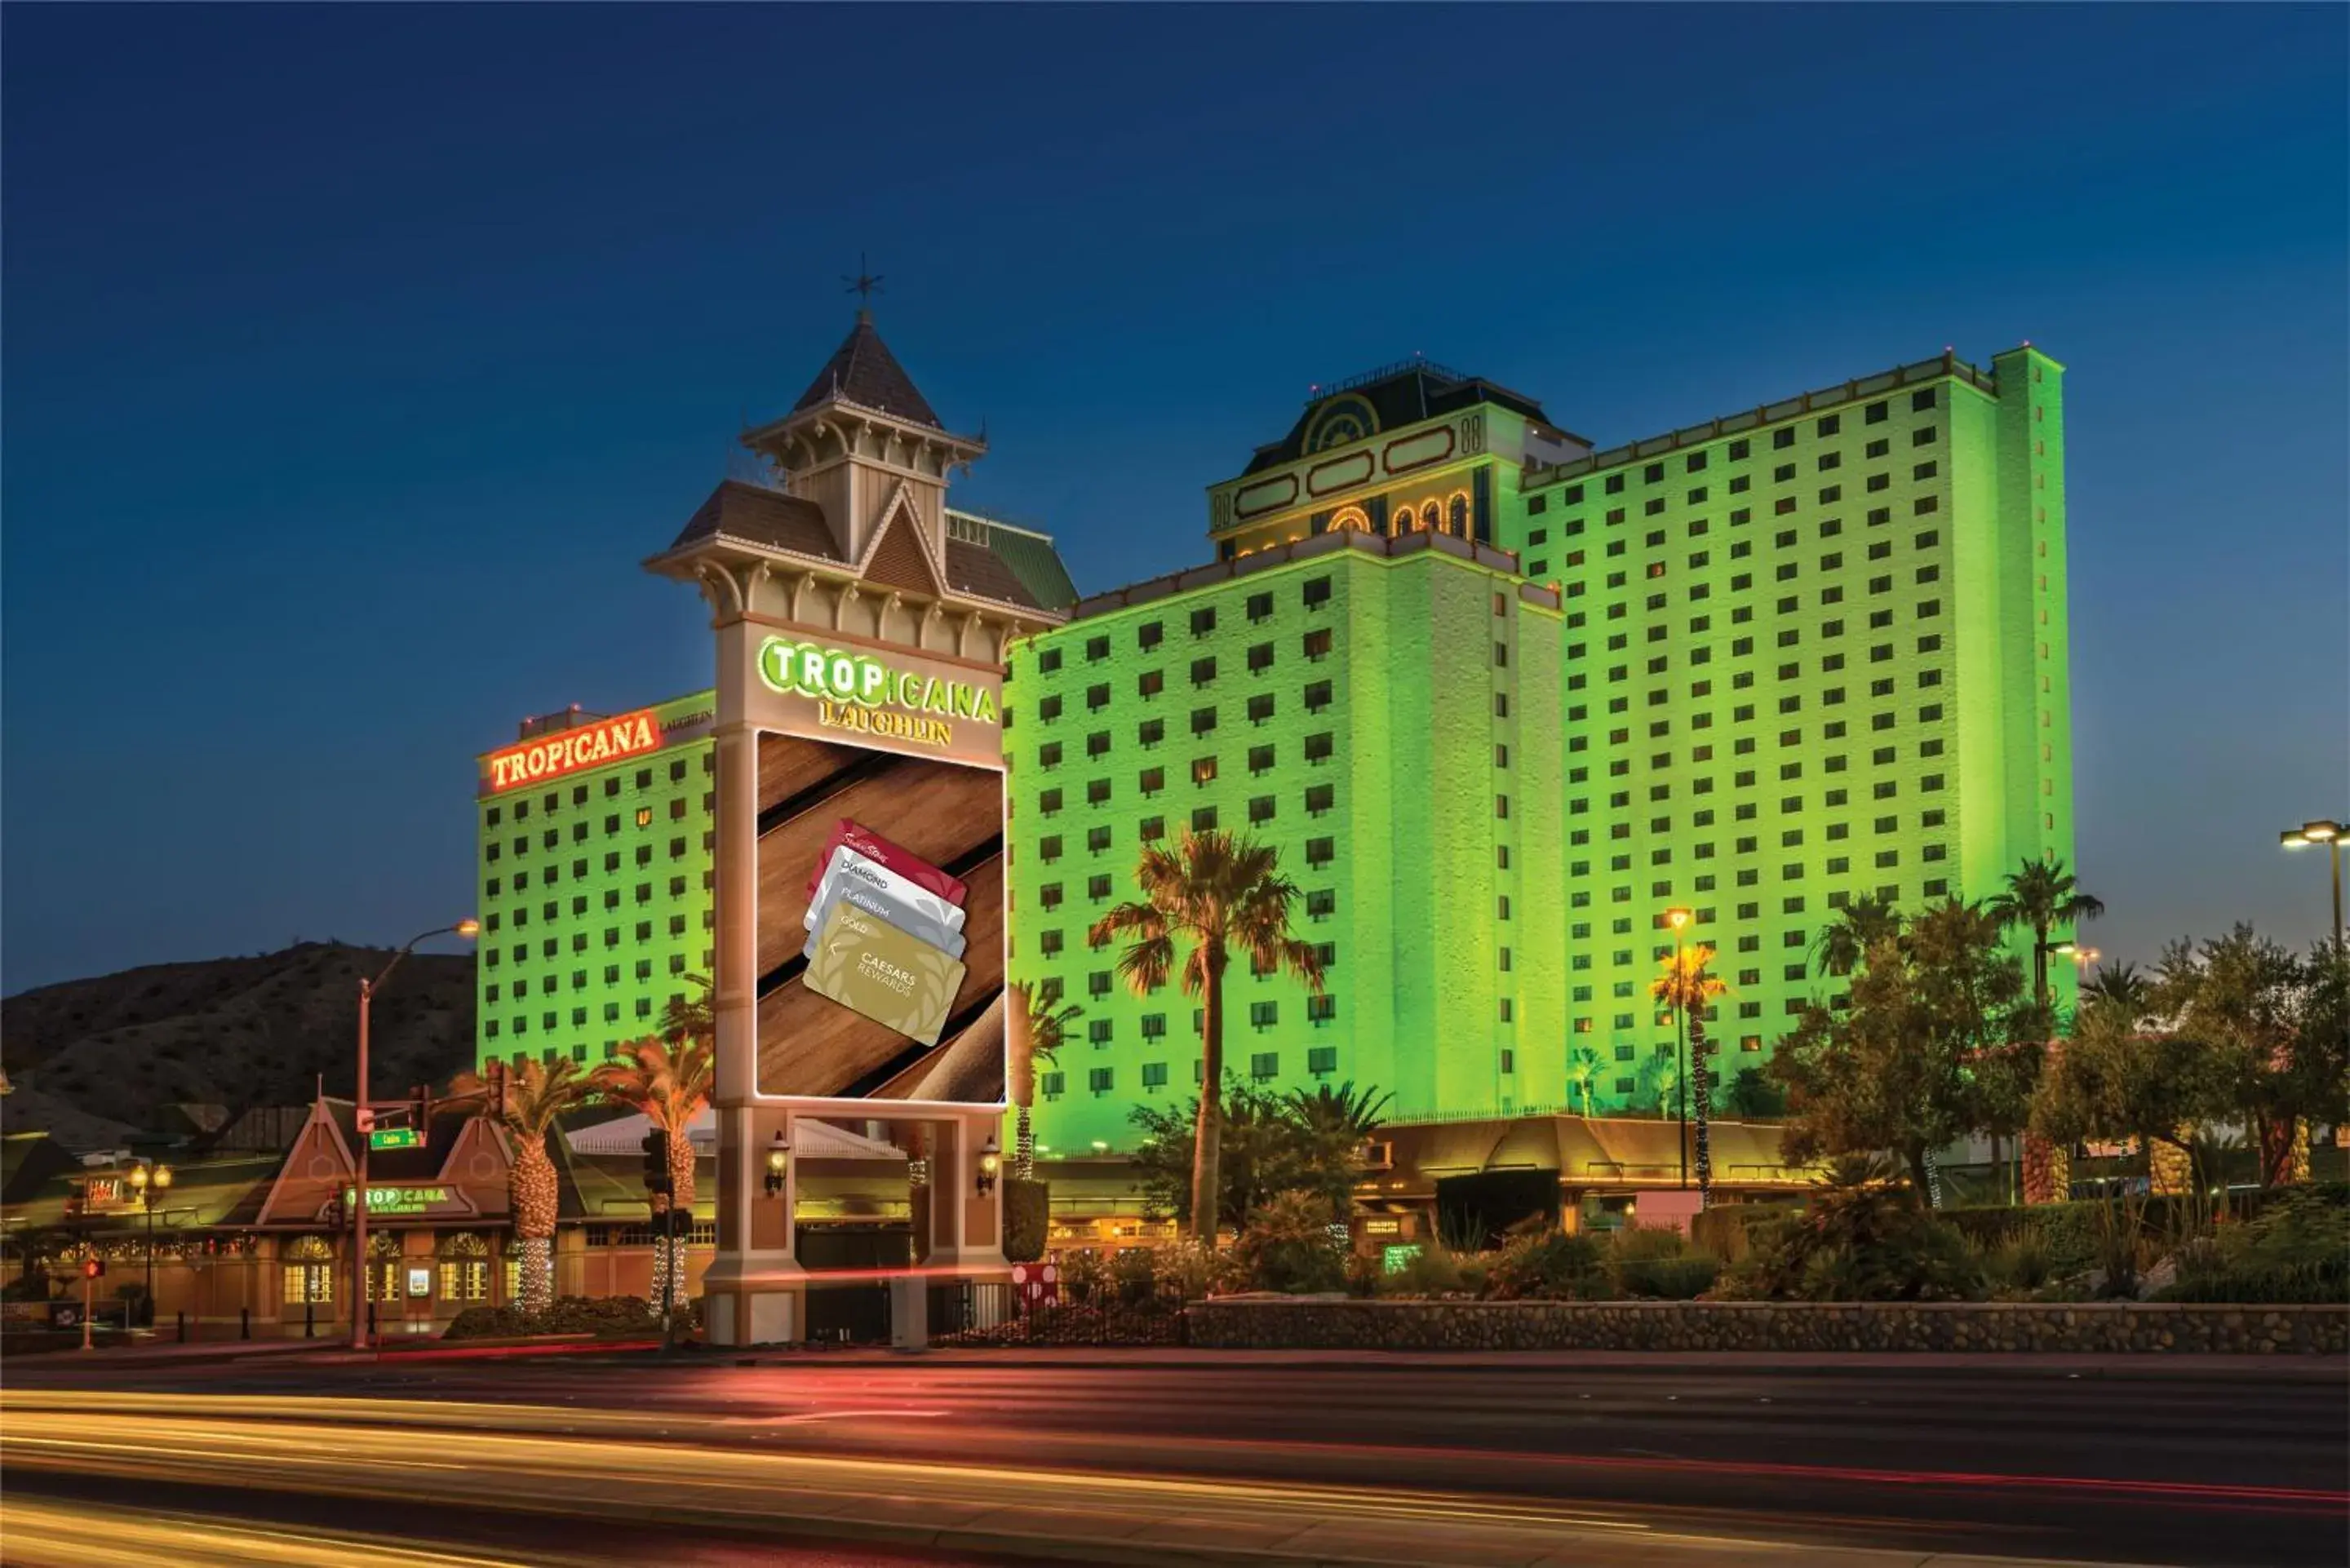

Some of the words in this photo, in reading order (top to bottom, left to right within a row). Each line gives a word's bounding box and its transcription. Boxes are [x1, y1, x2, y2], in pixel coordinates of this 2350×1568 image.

[771, 644, 999, 724] TROPICANA
[818, 700, 952, 746] LAUGHLIN
[492, 717, 654, 786] TROPICANA
[841, 861, 888, 889] DIAMOND
[840, 887, 890, 917] PLATINUM
[840, 915, 868, 934] GOLD
[857, 962, 912, 998] REWARDS
[861, 952, 916, 986] CAESARS
